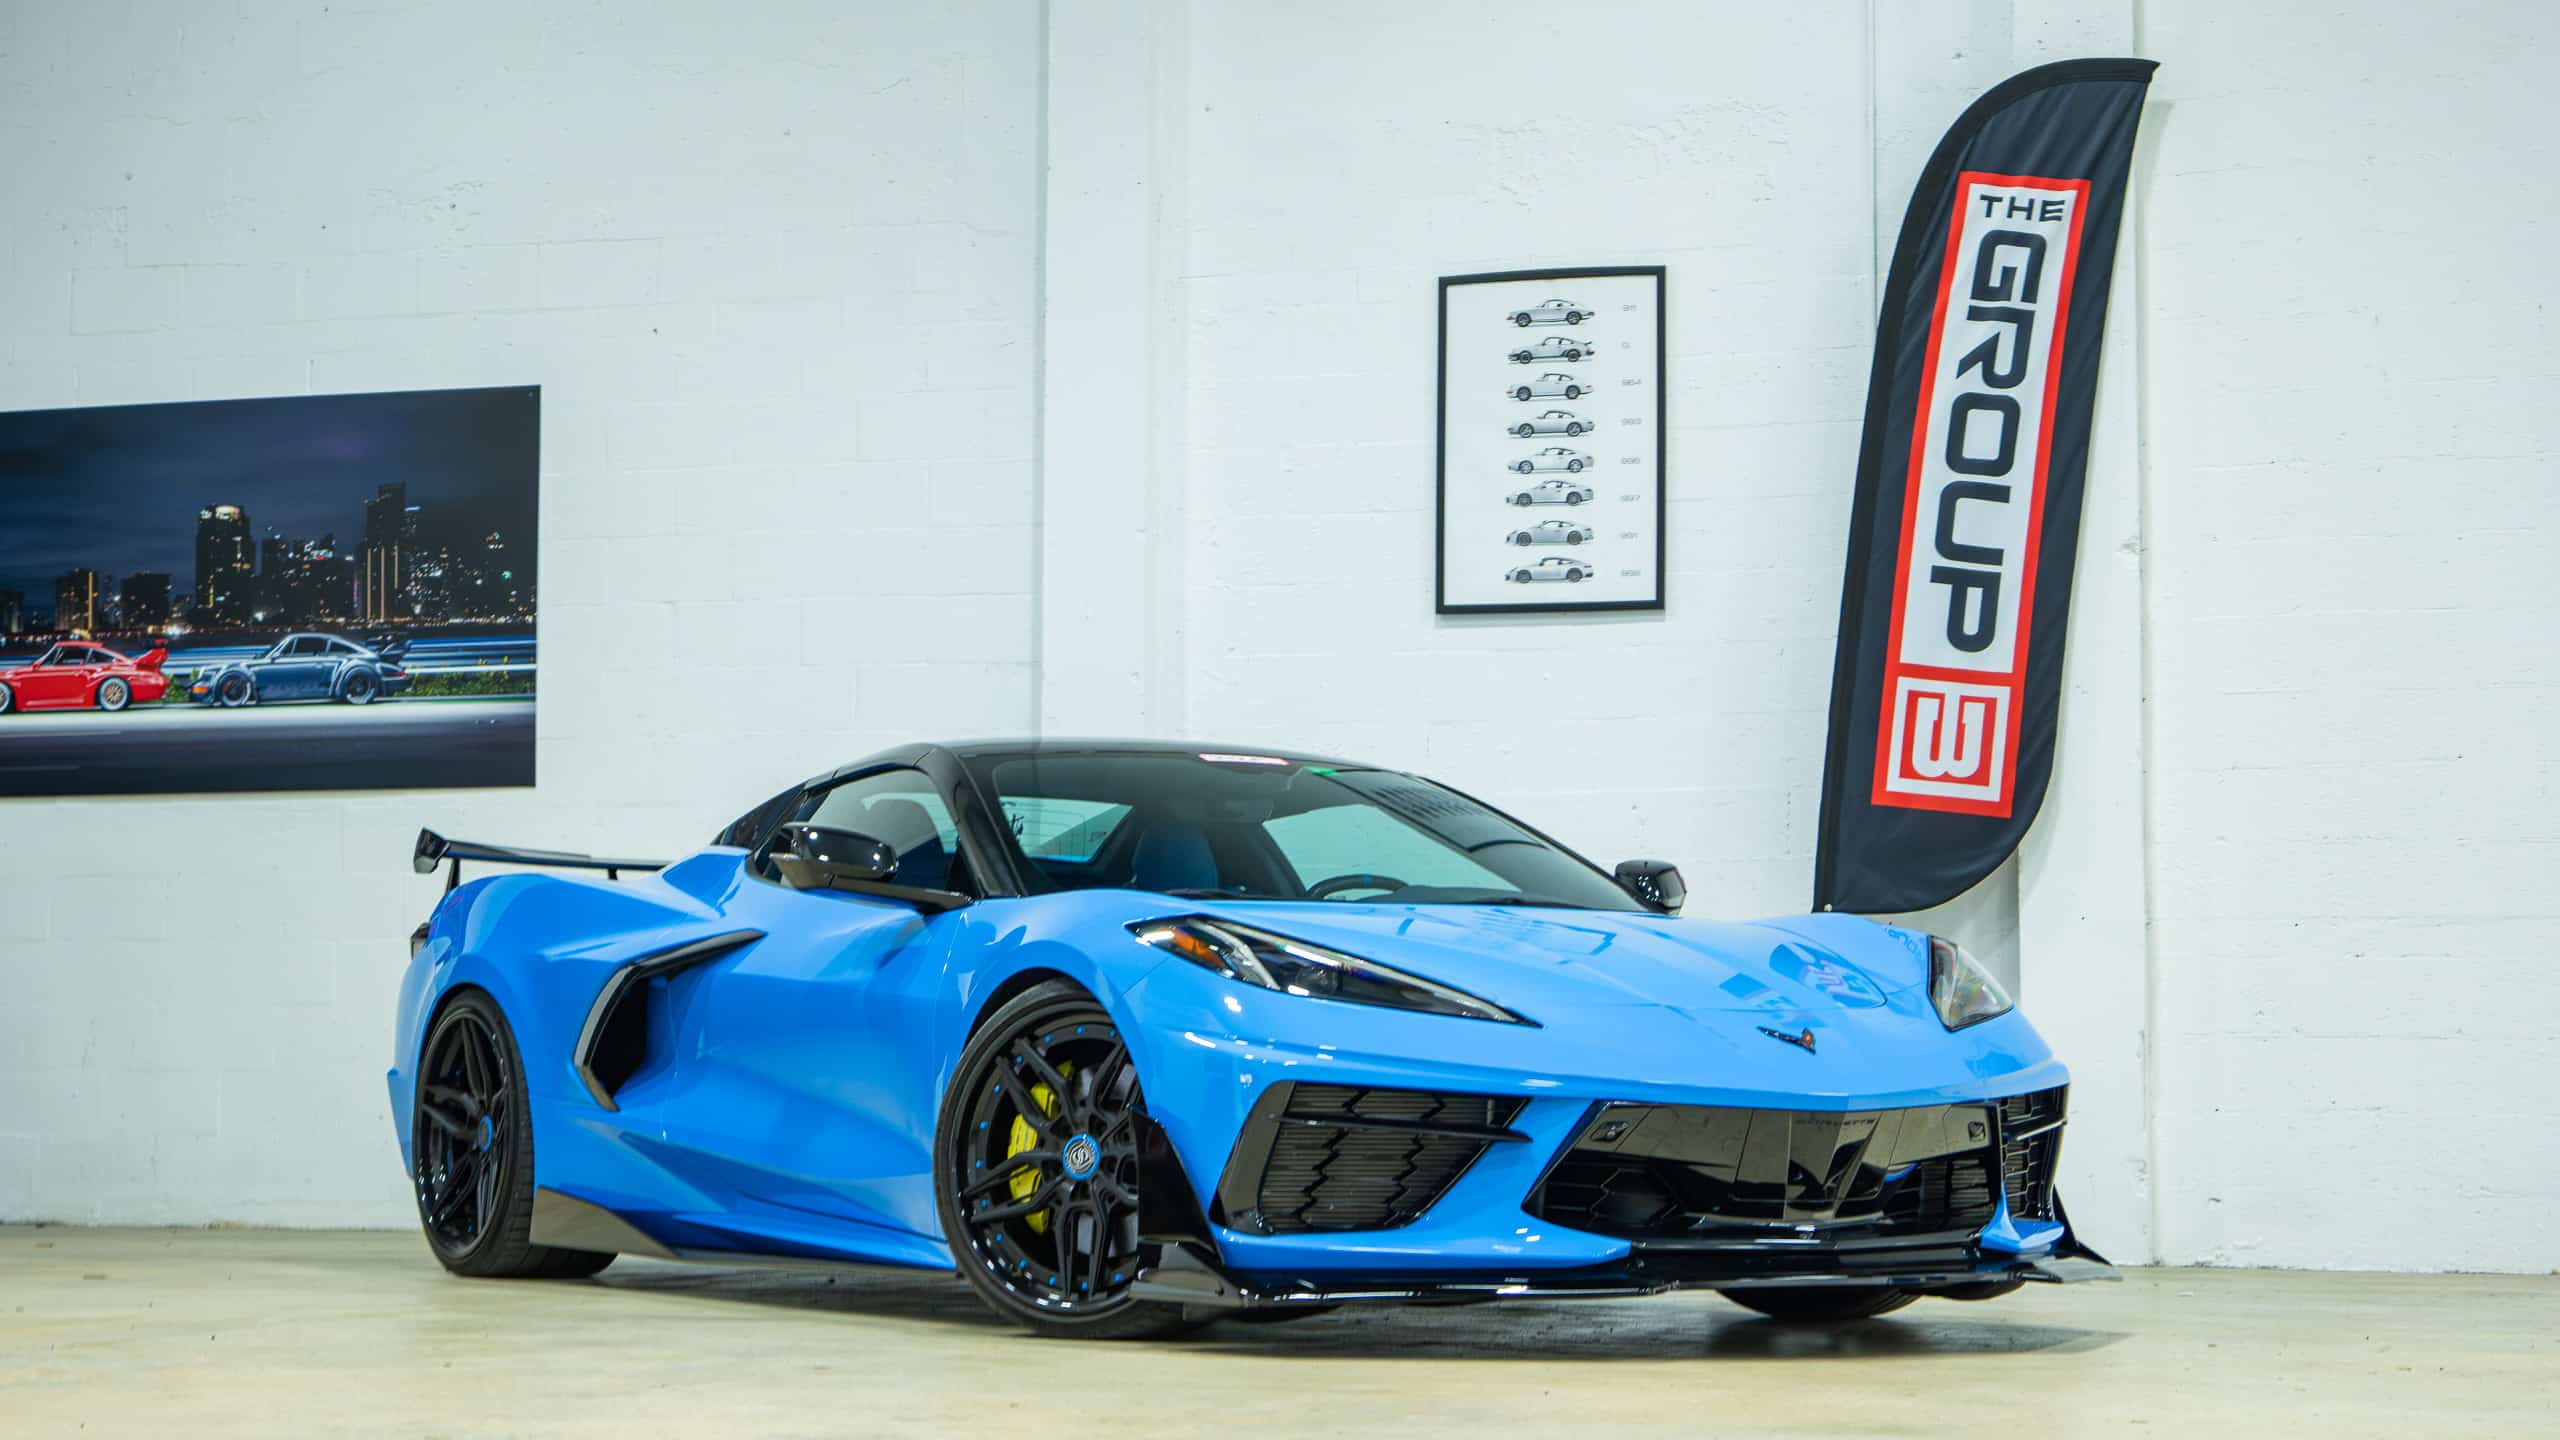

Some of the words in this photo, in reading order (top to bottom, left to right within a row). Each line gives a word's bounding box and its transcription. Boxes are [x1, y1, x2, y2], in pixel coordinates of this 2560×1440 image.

[1979, 194, 2066, 223] THE
[1929, 229, 2047, 653] GROUP
[1911, 696, 1986, 779] 3
